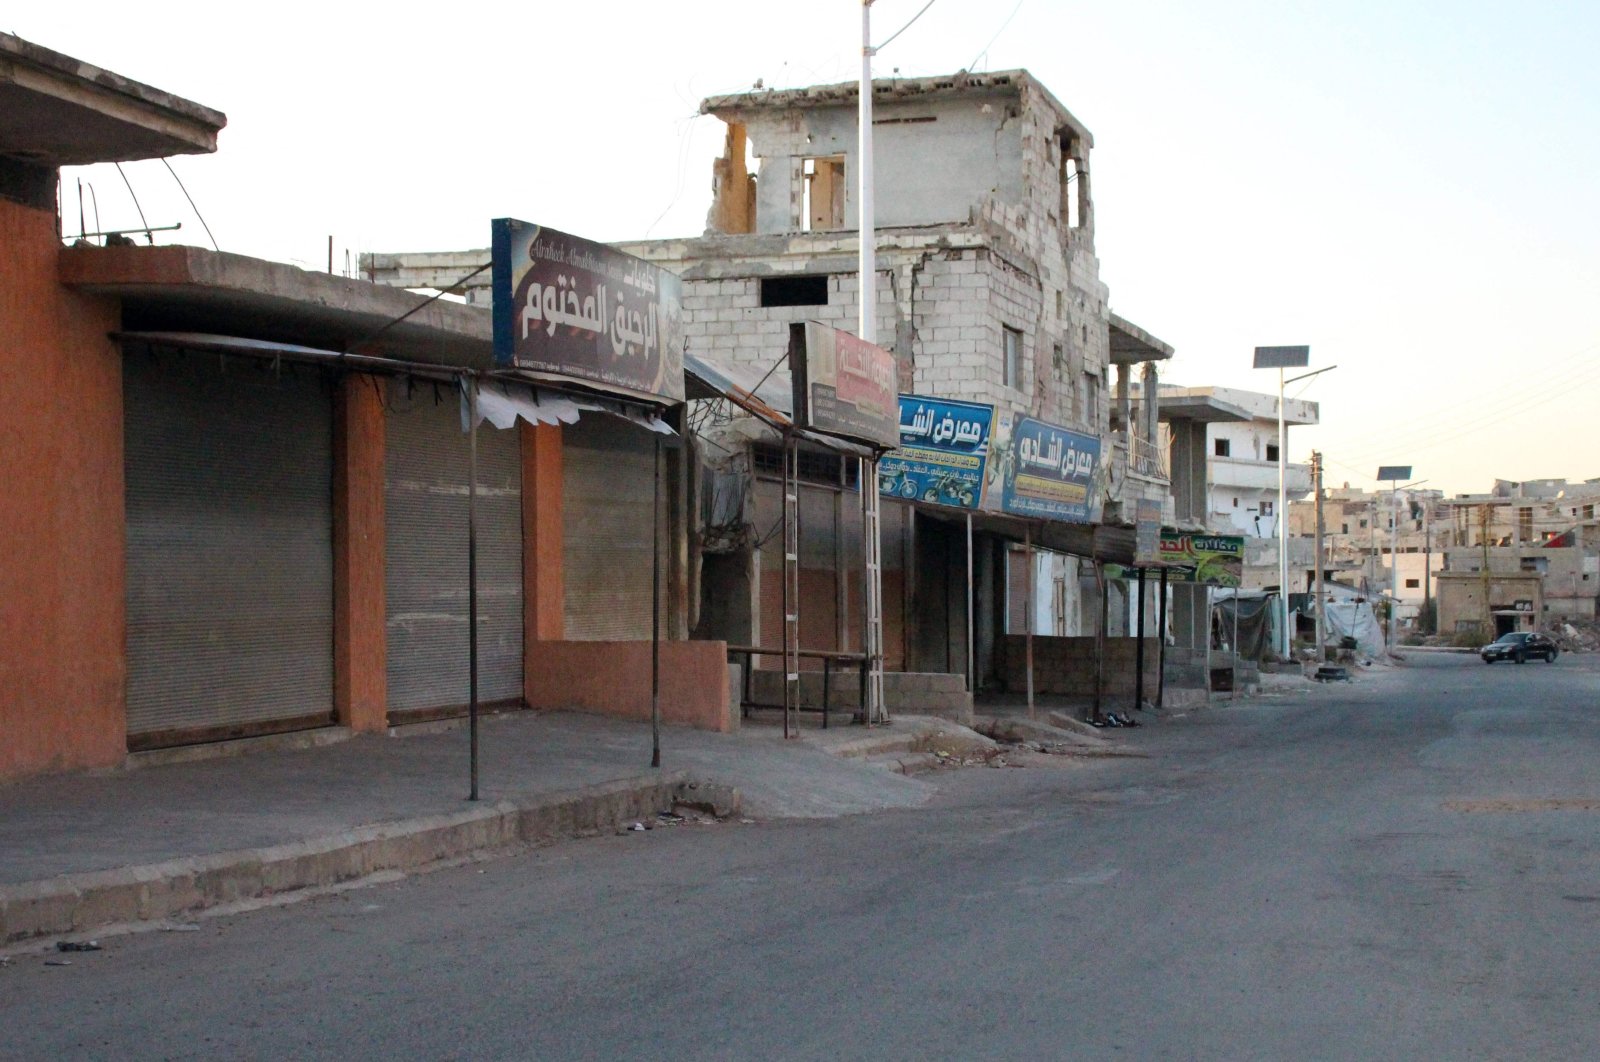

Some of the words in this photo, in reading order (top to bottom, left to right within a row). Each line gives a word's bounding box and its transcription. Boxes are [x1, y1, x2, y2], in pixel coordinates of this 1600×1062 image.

[623, 259, 656, 297] حلويات
[522, 274, 607, 340] المختوم
[611, 290, 658, 360] الرحيق
[932, 411, 981, 446] معرض
[1061, 440, 1093, 480] معرض
[1195, 538, 1238, 553] مخللات
